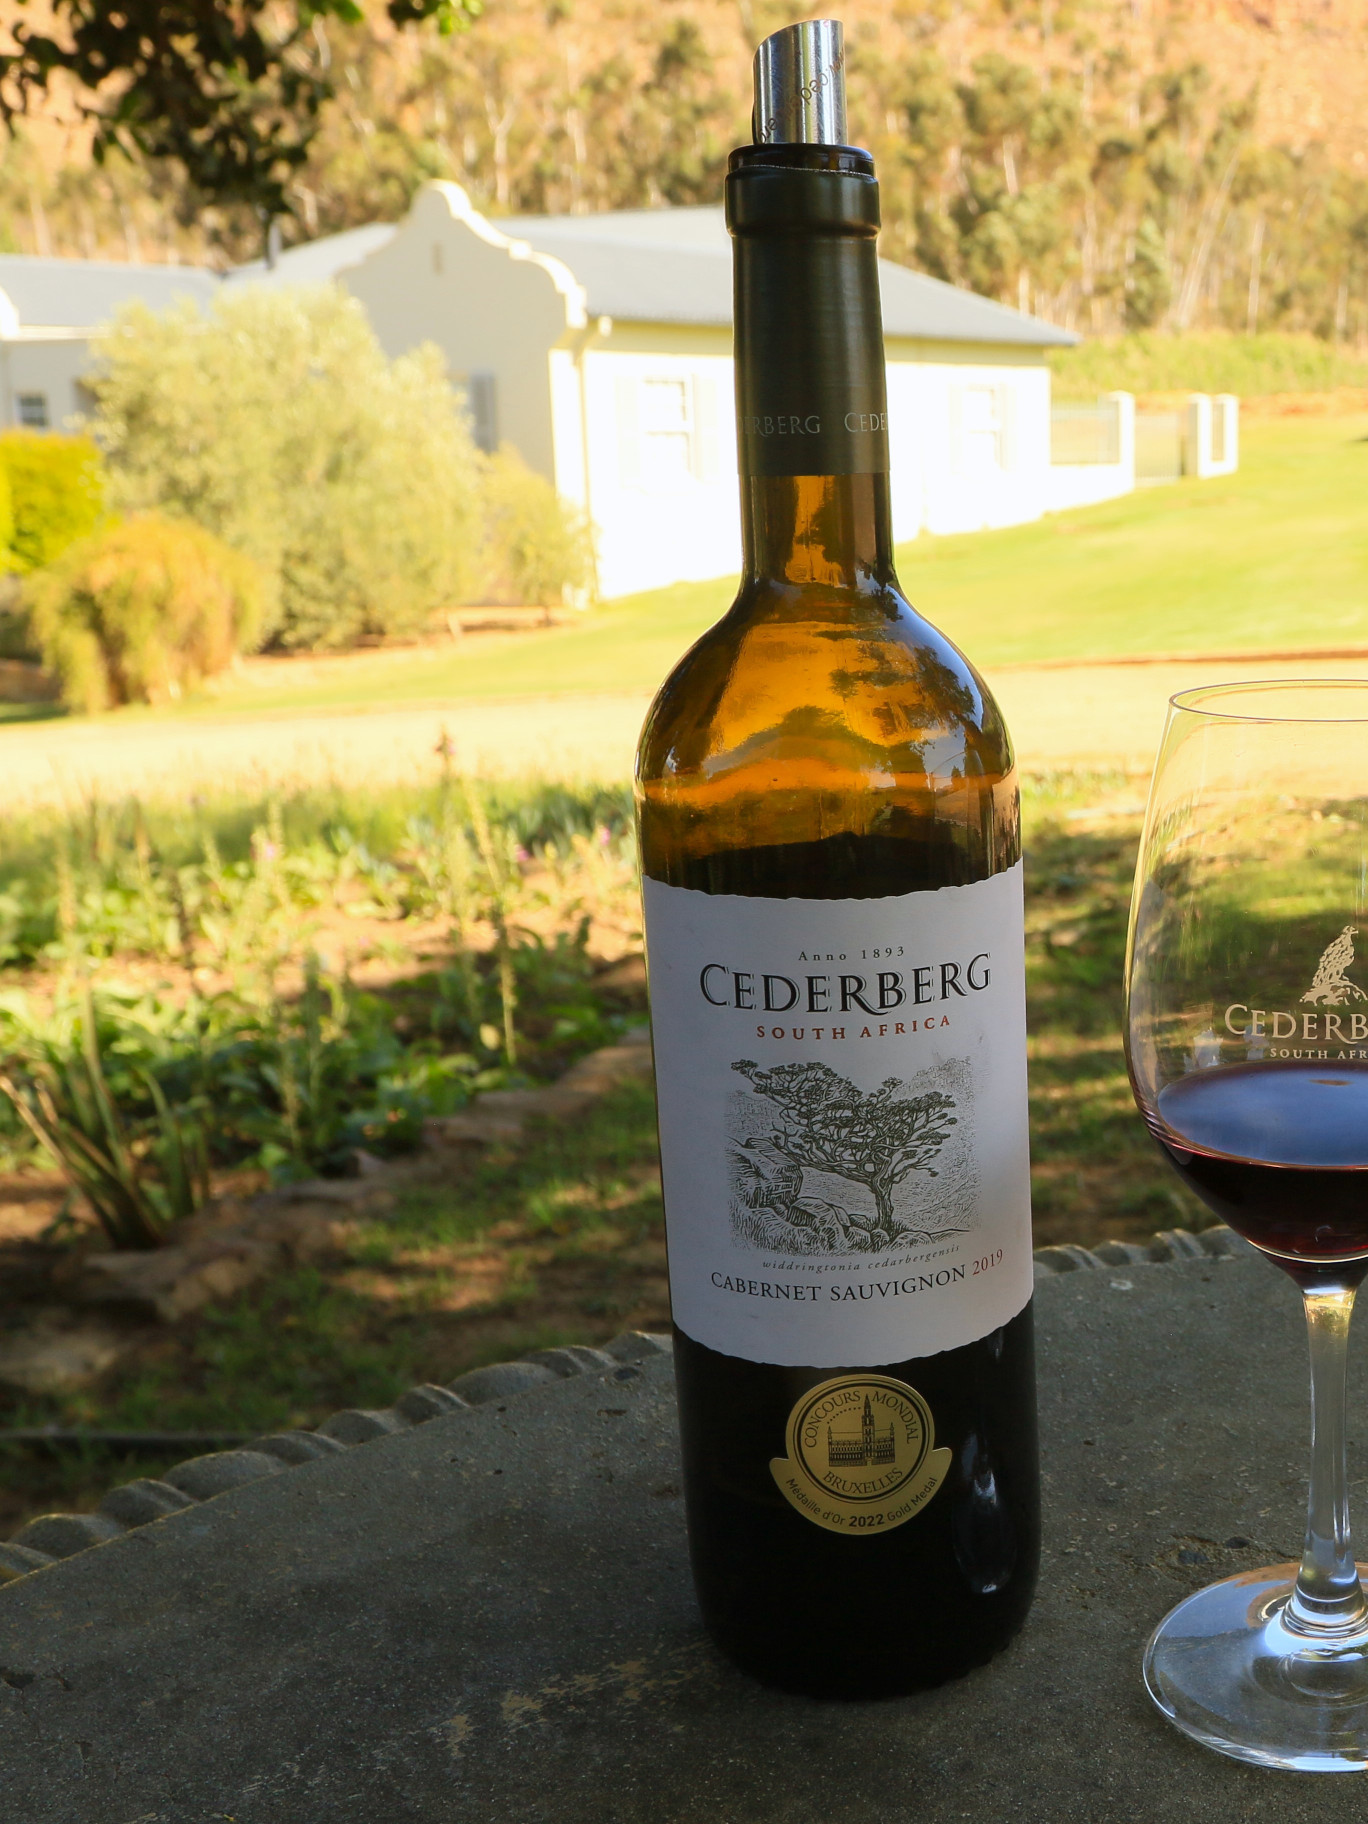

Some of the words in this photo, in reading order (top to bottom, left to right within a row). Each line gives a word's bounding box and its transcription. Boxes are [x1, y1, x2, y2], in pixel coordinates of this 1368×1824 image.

[844, 412, 887, 433] CEDE
[798, 951, 847, 961] Anno
[861, 946, 905, 960] 1893
[700, 952, 991, 1016] CEDERBERG
[757, 1025, 846, 1040] SOUTH
[860, 1015, 950, 1038] AFRICA
[1270, 1048, 1328, 1059] SOUTH
[711, 1271, 822, 1301] CABERNET
[830, 1264, 967, 1301] SAUVIGNON
[972, 1248, 1004, 1276] 2019
[762, 1260, 860, 1274] widdringtonia
[804, 1390, 861, 1448] CONCOURS
[872, 1391, 919, 1445] MONDIAL
[823, 1467, 903, 1494] BRUXELLES
[785, 1478, 821, 1515] Médaille
[849, 1514, 885, 1527] 2022
[887, 1504, 912, 1522] Gold
[911, 1477, 938, 1507] Medal
